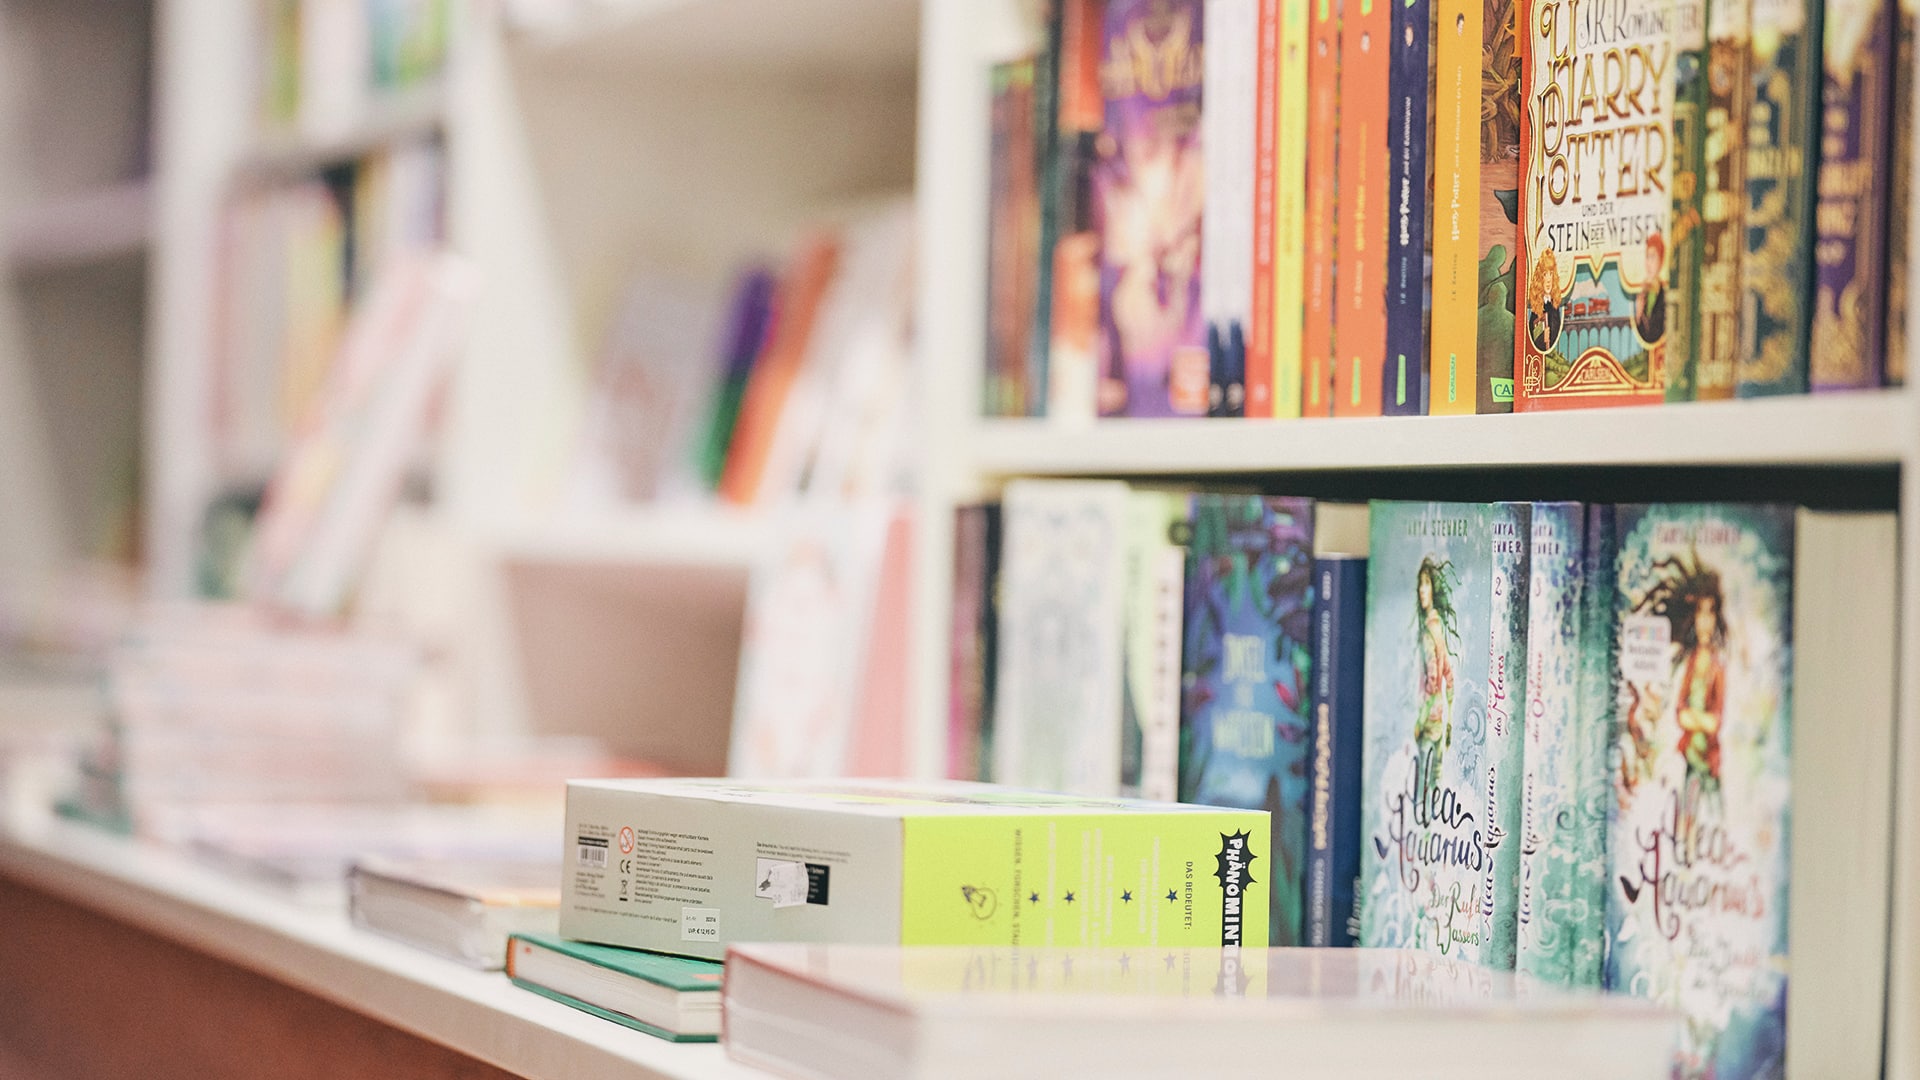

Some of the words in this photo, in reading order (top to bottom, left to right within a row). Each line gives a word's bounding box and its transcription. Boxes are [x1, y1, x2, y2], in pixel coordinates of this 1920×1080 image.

[1540, 2, 1671, 129] HARRY
[1535, 82, 1667, 242] POTTER
[1450, 171, 1461, 209] Potter
[1581, 204, 1597, 217] UND
[1599, 202, 1614, 216] DER
[1547, 220, 1590, 252] STEIN
[1607, 213, 1664, 249] WEISEN
[1494, 576, 1502, 596] 2
[1406, 747, 1474, 829] Alea
[1374, 792, 1482, 893] Aquarius
[1185, 861, 1194, 879] DAS
[1183, 881, 1193, 930] BEDEUTET:
